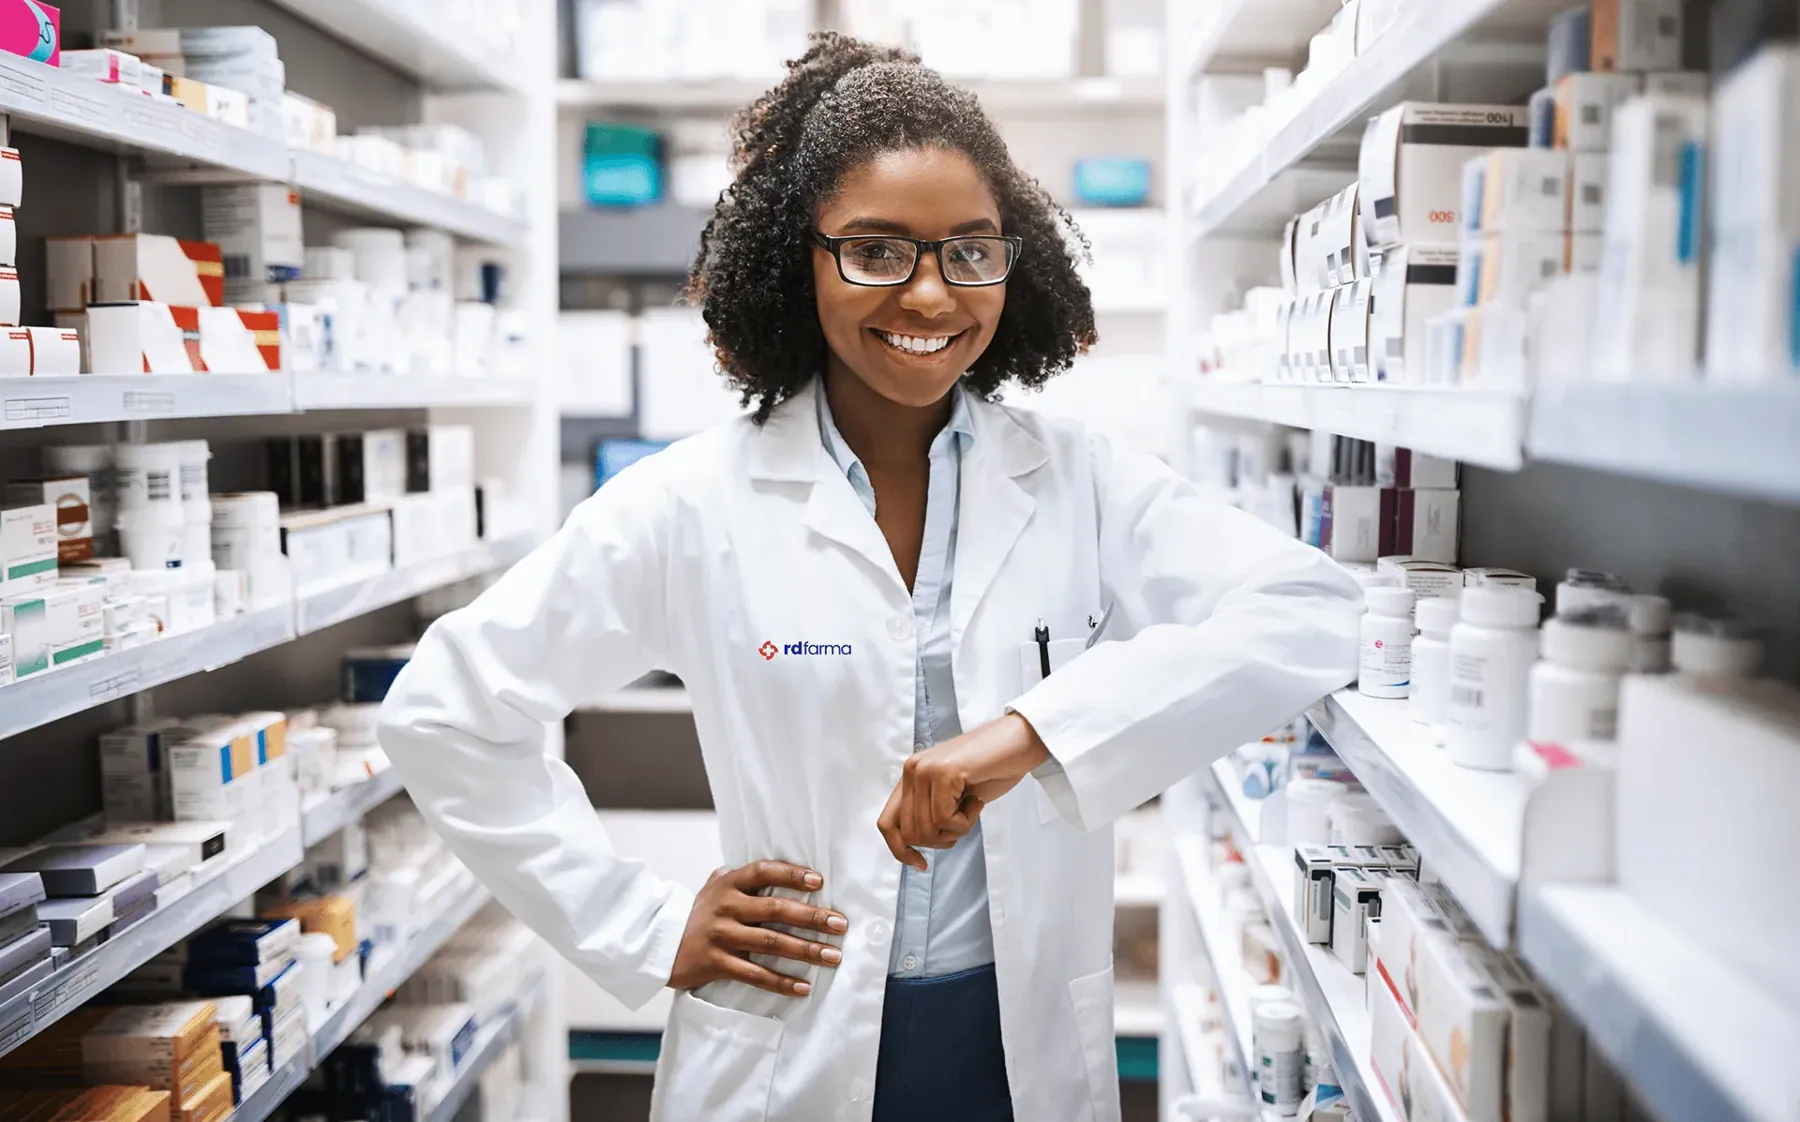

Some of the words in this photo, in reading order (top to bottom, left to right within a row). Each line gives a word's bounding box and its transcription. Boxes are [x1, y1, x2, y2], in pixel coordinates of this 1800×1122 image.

[1486, 112, 1509, 124] 100
[1429, 210, 1455, 223] 500
[784, 641, 852, 655] rdfarma
